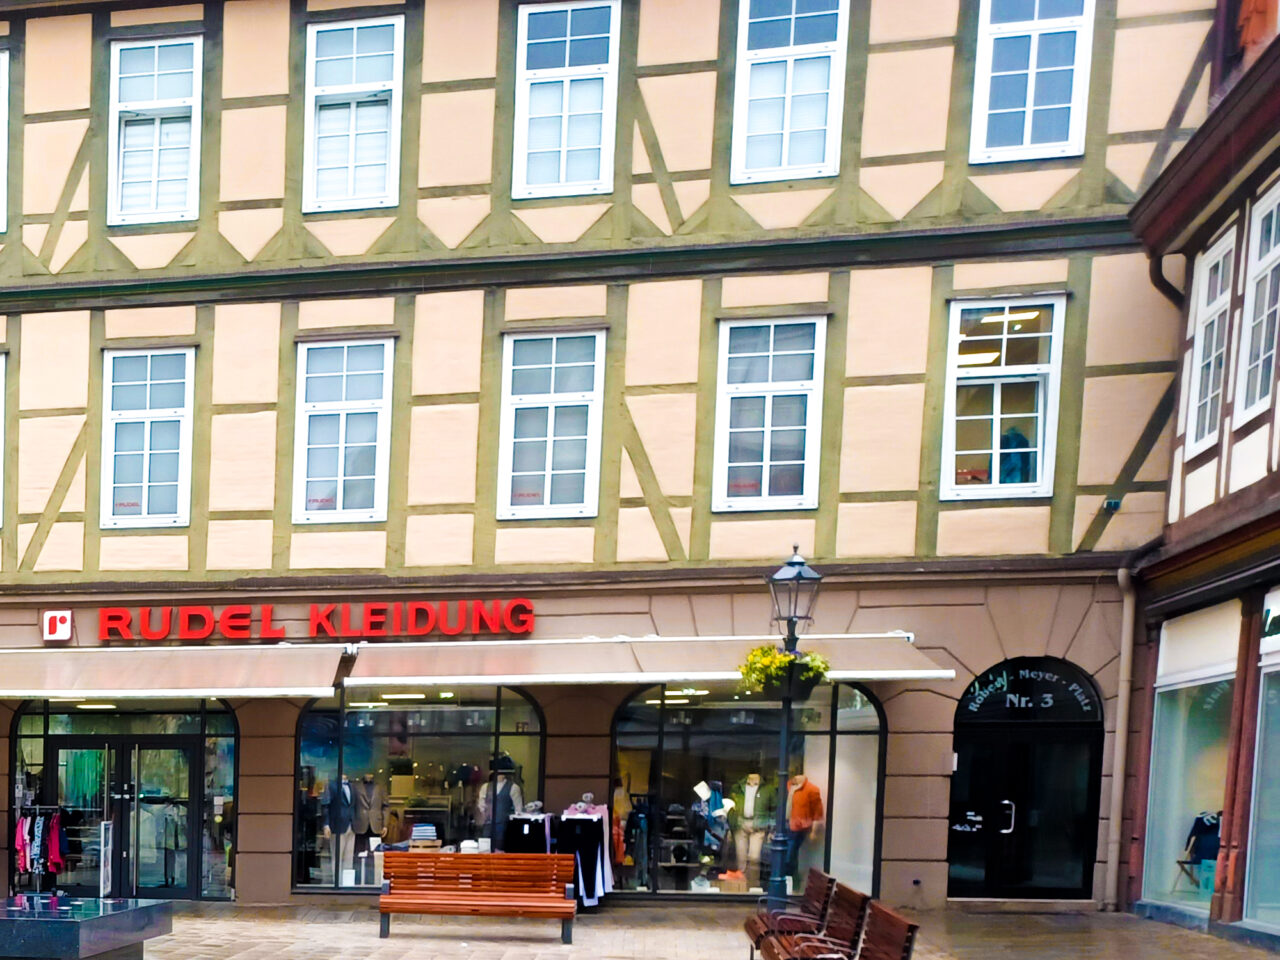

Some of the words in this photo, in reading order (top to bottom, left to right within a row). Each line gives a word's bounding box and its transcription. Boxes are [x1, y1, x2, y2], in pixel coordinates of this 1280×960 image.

[99, 604, 286, 640] RUDEL
[309, 597, 535, 638] KLEIDUNG
[1006, 693, 1033, 708] Nr.
[1040, 693, 1054, 708] 3
